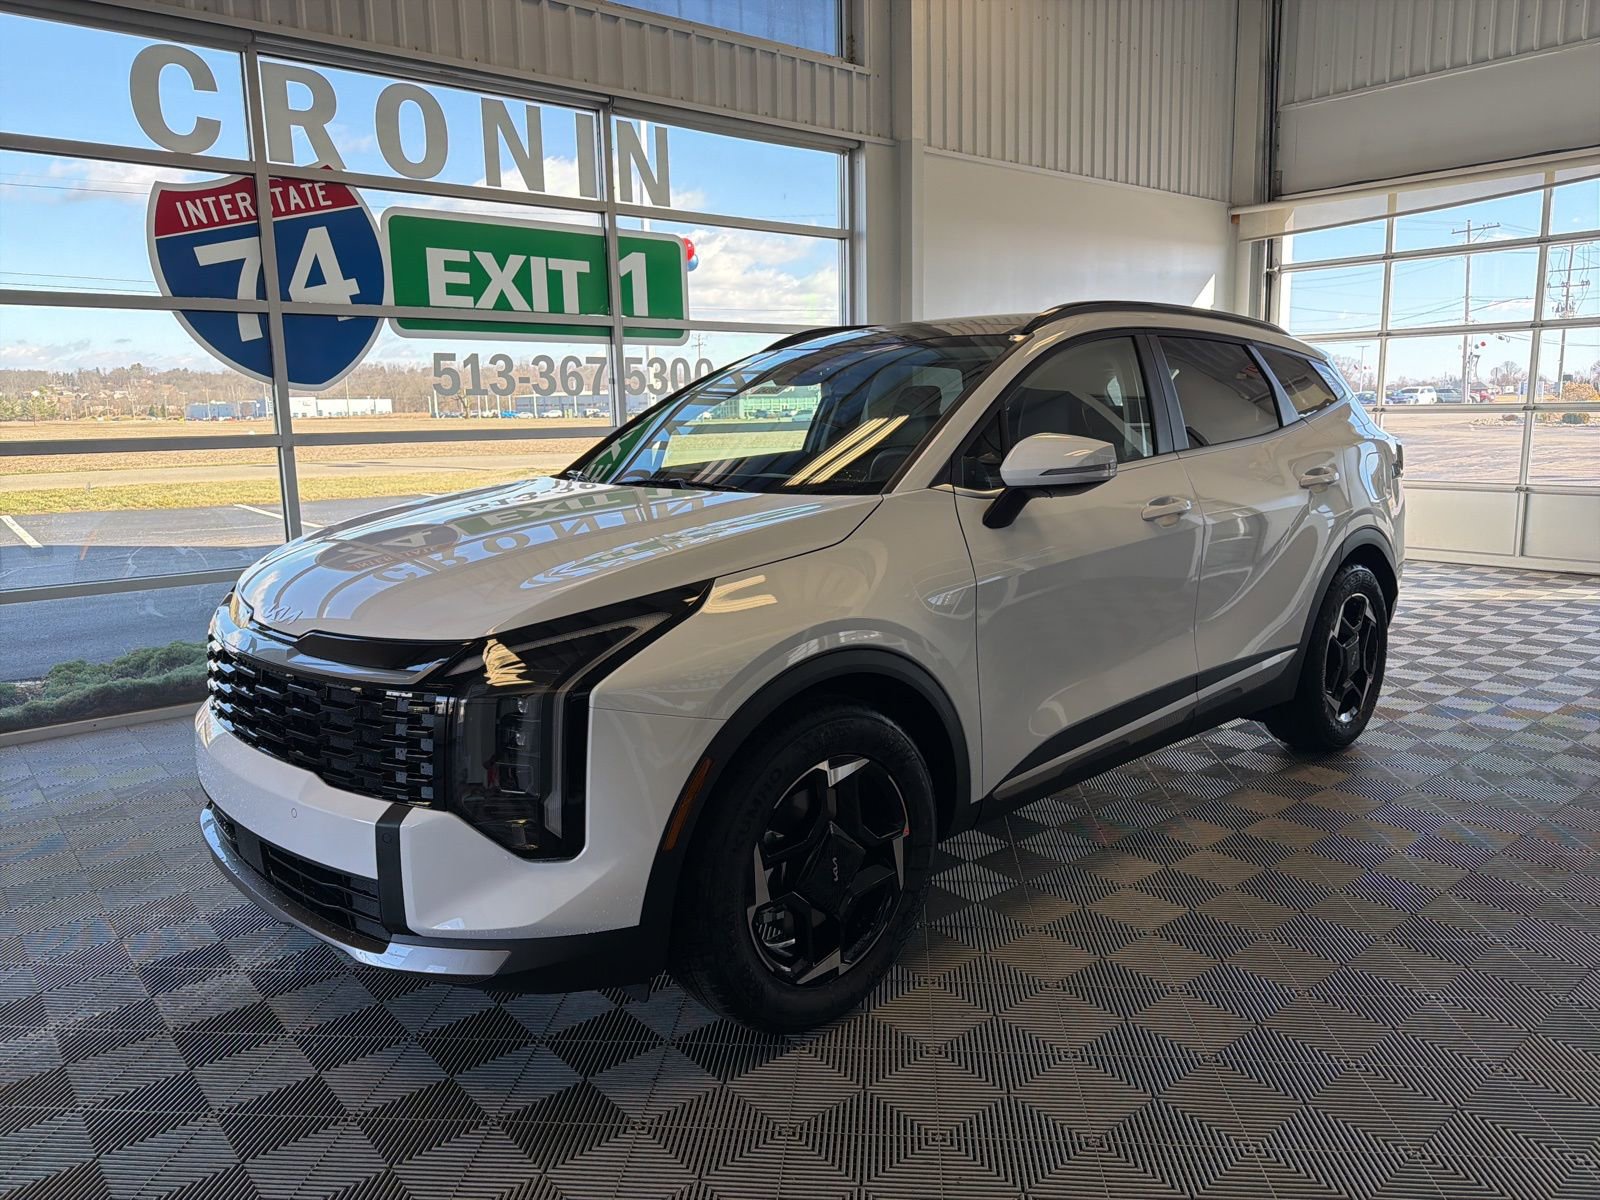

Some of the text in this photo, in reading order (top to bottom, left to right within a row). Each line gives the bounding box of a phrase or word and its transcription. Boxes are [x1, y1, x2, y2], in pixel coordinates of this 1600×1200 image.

[129, 43, 672, 208] CRONIN
[175, 181, 333, 228] INTERTATE
[193, 226, 361, 342] 74
[425, 247, 649, 317] EXIT 1
[432, 352, 714, 397] 513-367530
